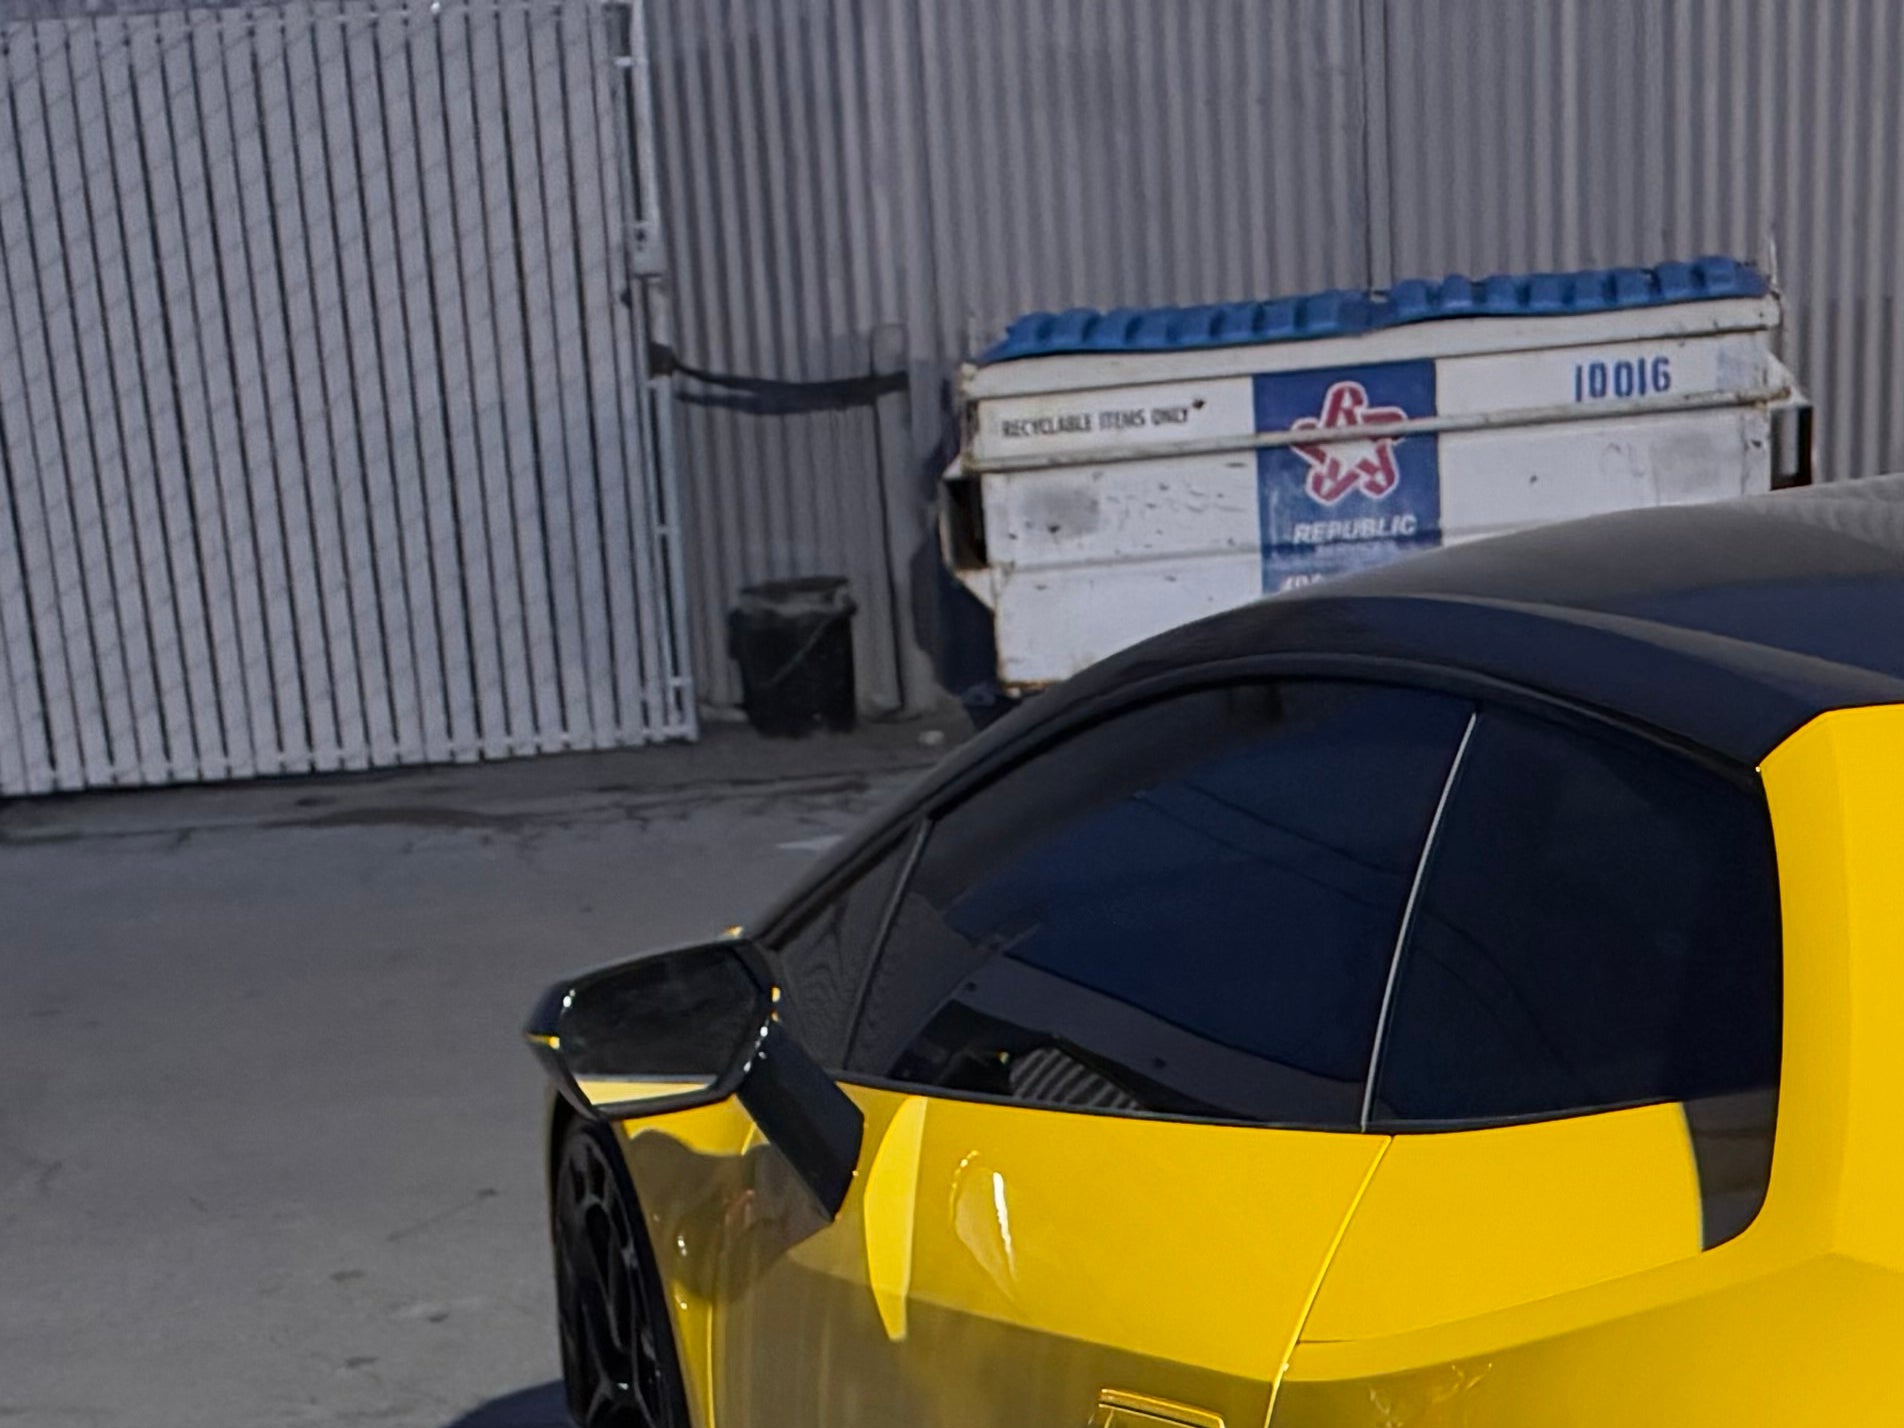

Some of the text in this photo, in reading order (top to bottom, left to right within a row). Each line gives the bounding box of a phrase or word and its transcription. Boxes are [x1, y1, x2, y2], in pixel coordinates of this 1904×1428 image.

[1575, 355, 1671, 403] 10016
[1001, 406, 1189, 437] RECYCLABLE ITEMS ONLY
[1292, 513, 1418, 545] REPUBLIC
